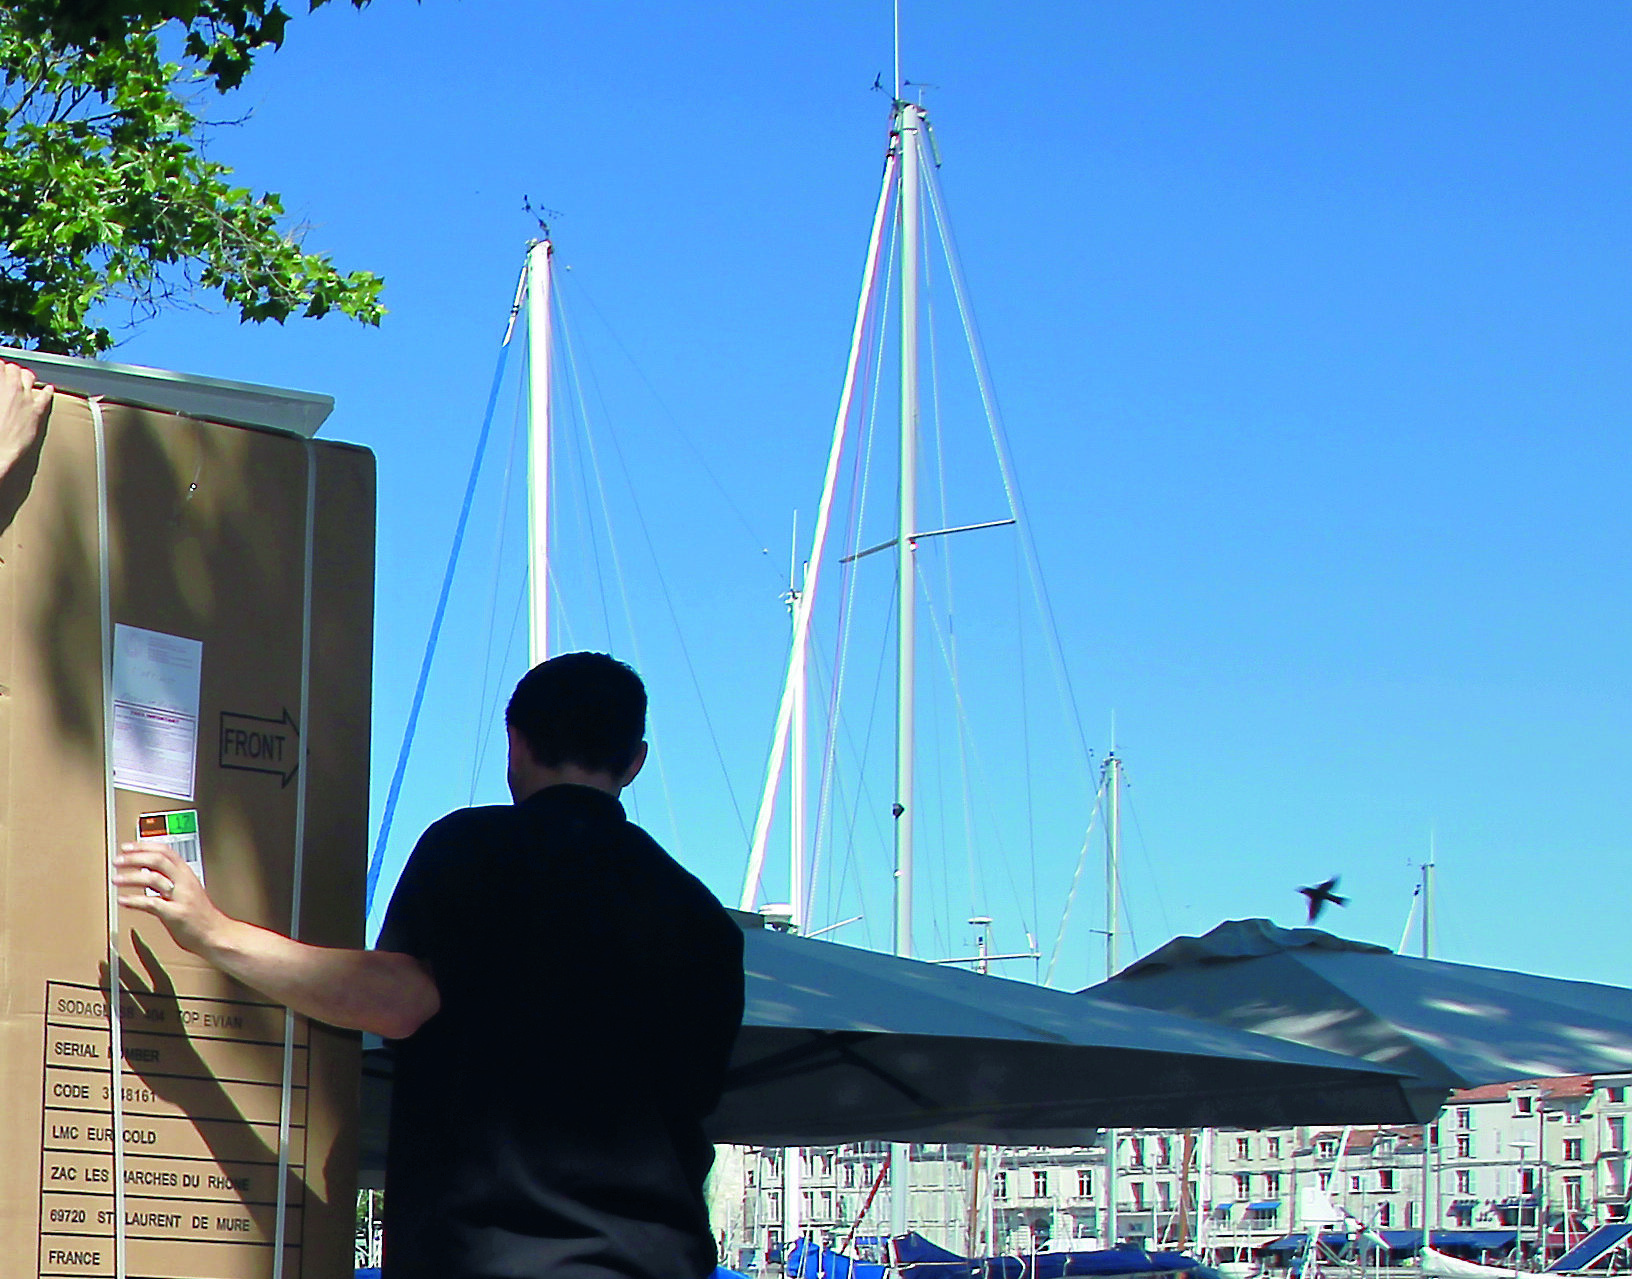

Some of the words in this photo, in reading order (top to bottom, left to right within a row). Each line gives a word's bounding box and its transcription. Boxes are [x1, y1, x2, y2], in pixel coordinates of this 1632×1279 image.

[224, 729, 285, 762] FRONT
[203, 1013, 243, 1030] EVIAN
[54, 1041, 100, 1058] SERIAL
[53, 1083, 89, 1099] CODE
[102, 1086, 156, 1103] 348161
[52, 1125, 79, 1139] LMC
[87, 1127, 156, 1144] EURCOLD
[51, 1166, 77, 1181] ZAC
[85, 1168, 109, 1183] LES
[182, 1173, 200, 1188] DU
[208, 1176, 250, 1191] RHONE
[50, 1209, 86, 1224] 69720
[124, 1213, 182, 1228] LAURENT
[192, 1215, 209, 1229] DE
[217, 1217, 251, 1232] MURE
[49, 1250, 100, 1266] FRANCE
